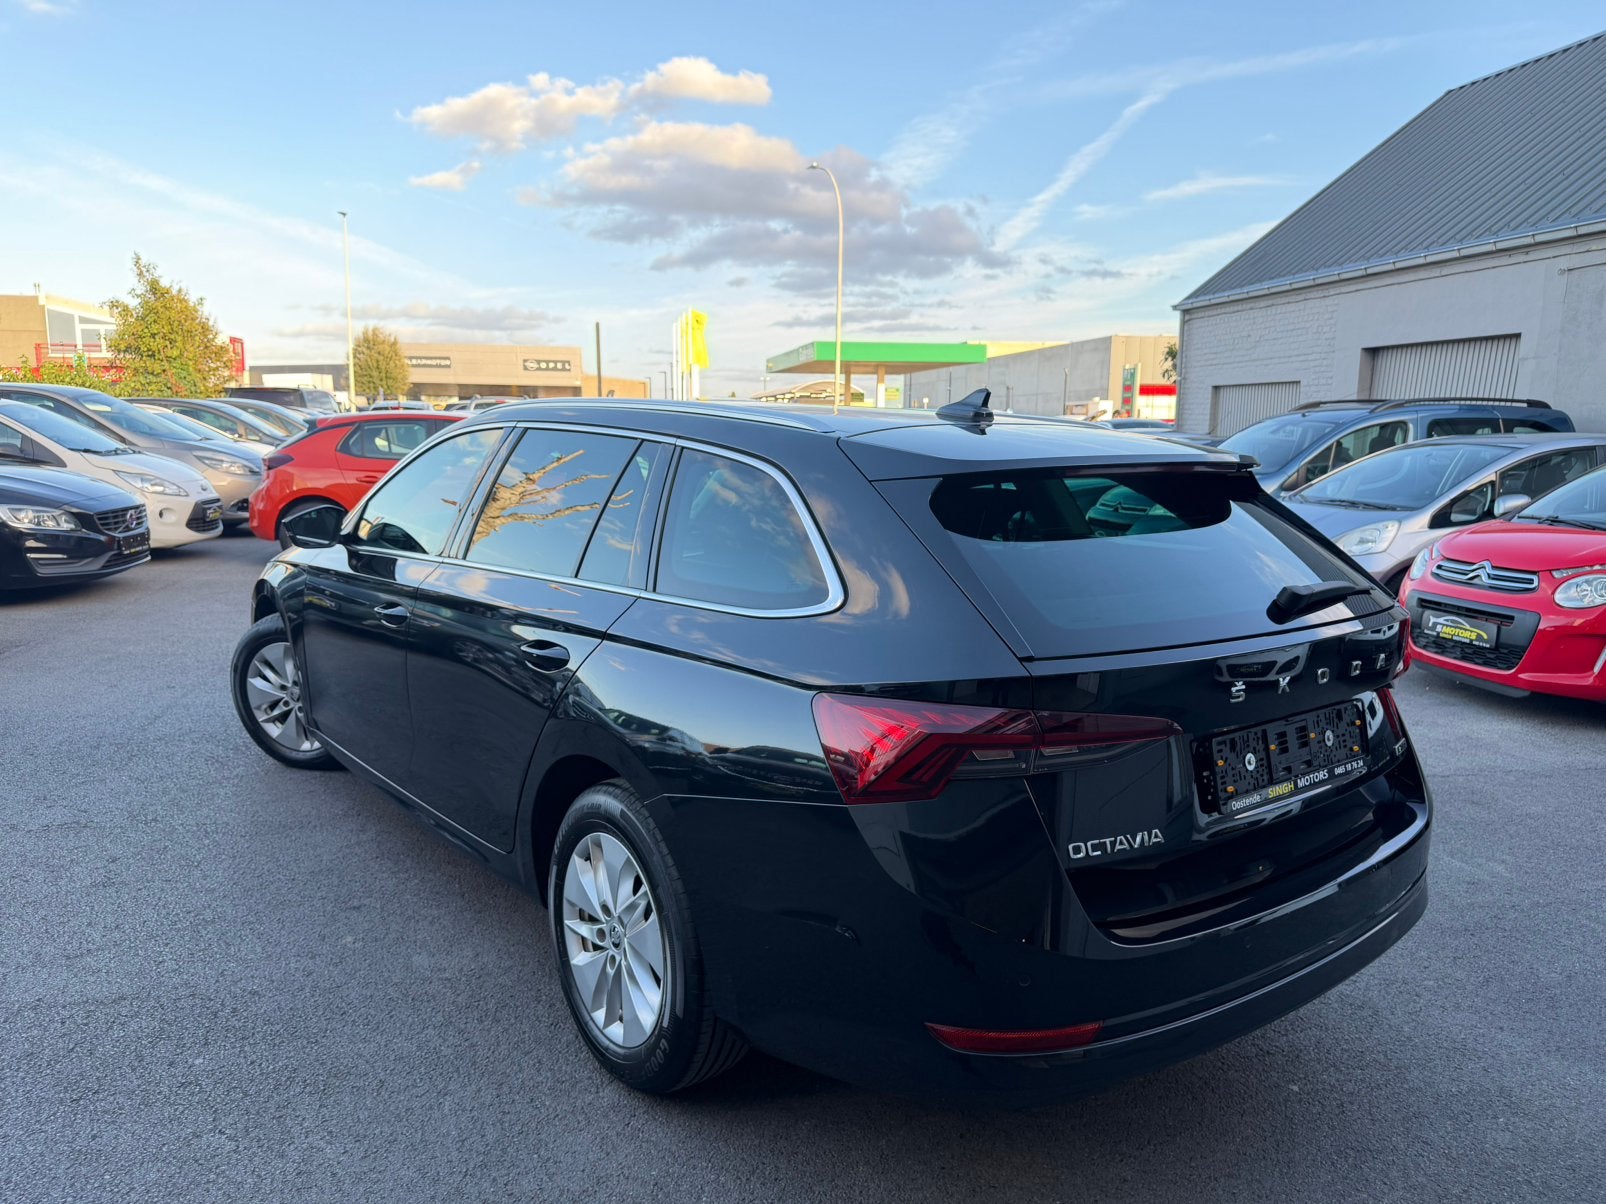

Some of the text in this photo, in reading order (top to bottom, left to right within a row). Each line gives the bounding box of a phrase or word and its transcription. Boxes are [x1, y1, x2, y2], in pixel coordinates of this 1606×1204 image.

[1442, 625, 1478, 640] MOTORS
[1231, 793, 1261, 811] Oostende
[1268, 781, 1295, 798] SINGH
[1297, 769, 1329, 788] MOTORS
[1068, 828, 1165, 859] OCTAVIA
